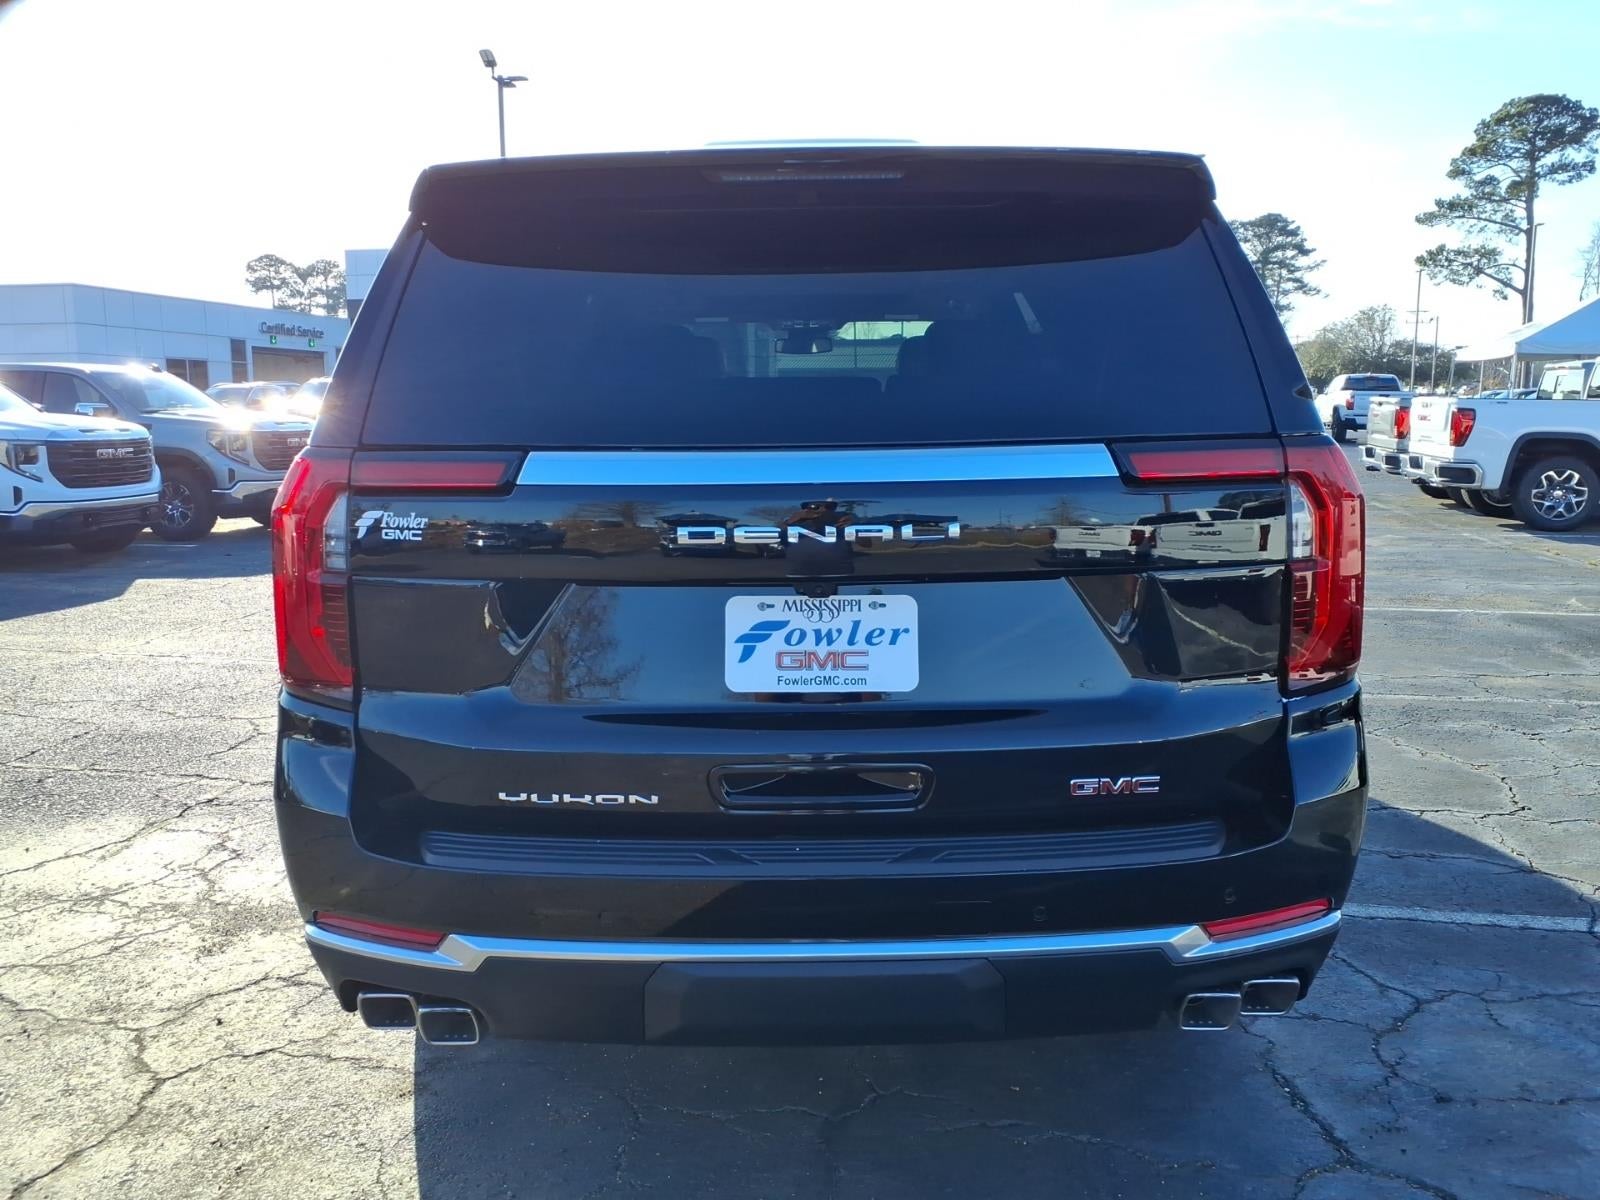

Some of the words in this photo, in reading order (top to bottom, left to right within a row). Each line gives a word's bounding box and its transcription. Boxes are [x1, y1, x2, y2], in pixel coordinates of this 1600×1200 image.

[259, 321, 295, 337] Certified
[297, 325, 324, 339] Service
[96, 447, 134, 458] GMC
[380, 511, 428, 529] Fowler
[381, 529, 422, 540] GMC
[676, 523, 960, 544] DENALI
[782, 599, 862, 623] MISSISSIPPI
[734, 619, 911, 663] Fowler
[775, 650, 869, 671] GMC
[776, 675, 867, 686] FowlerGMC.com
[1070, 776, 1160, 796] GMC
[498, 792, 659, 806] YUKON
